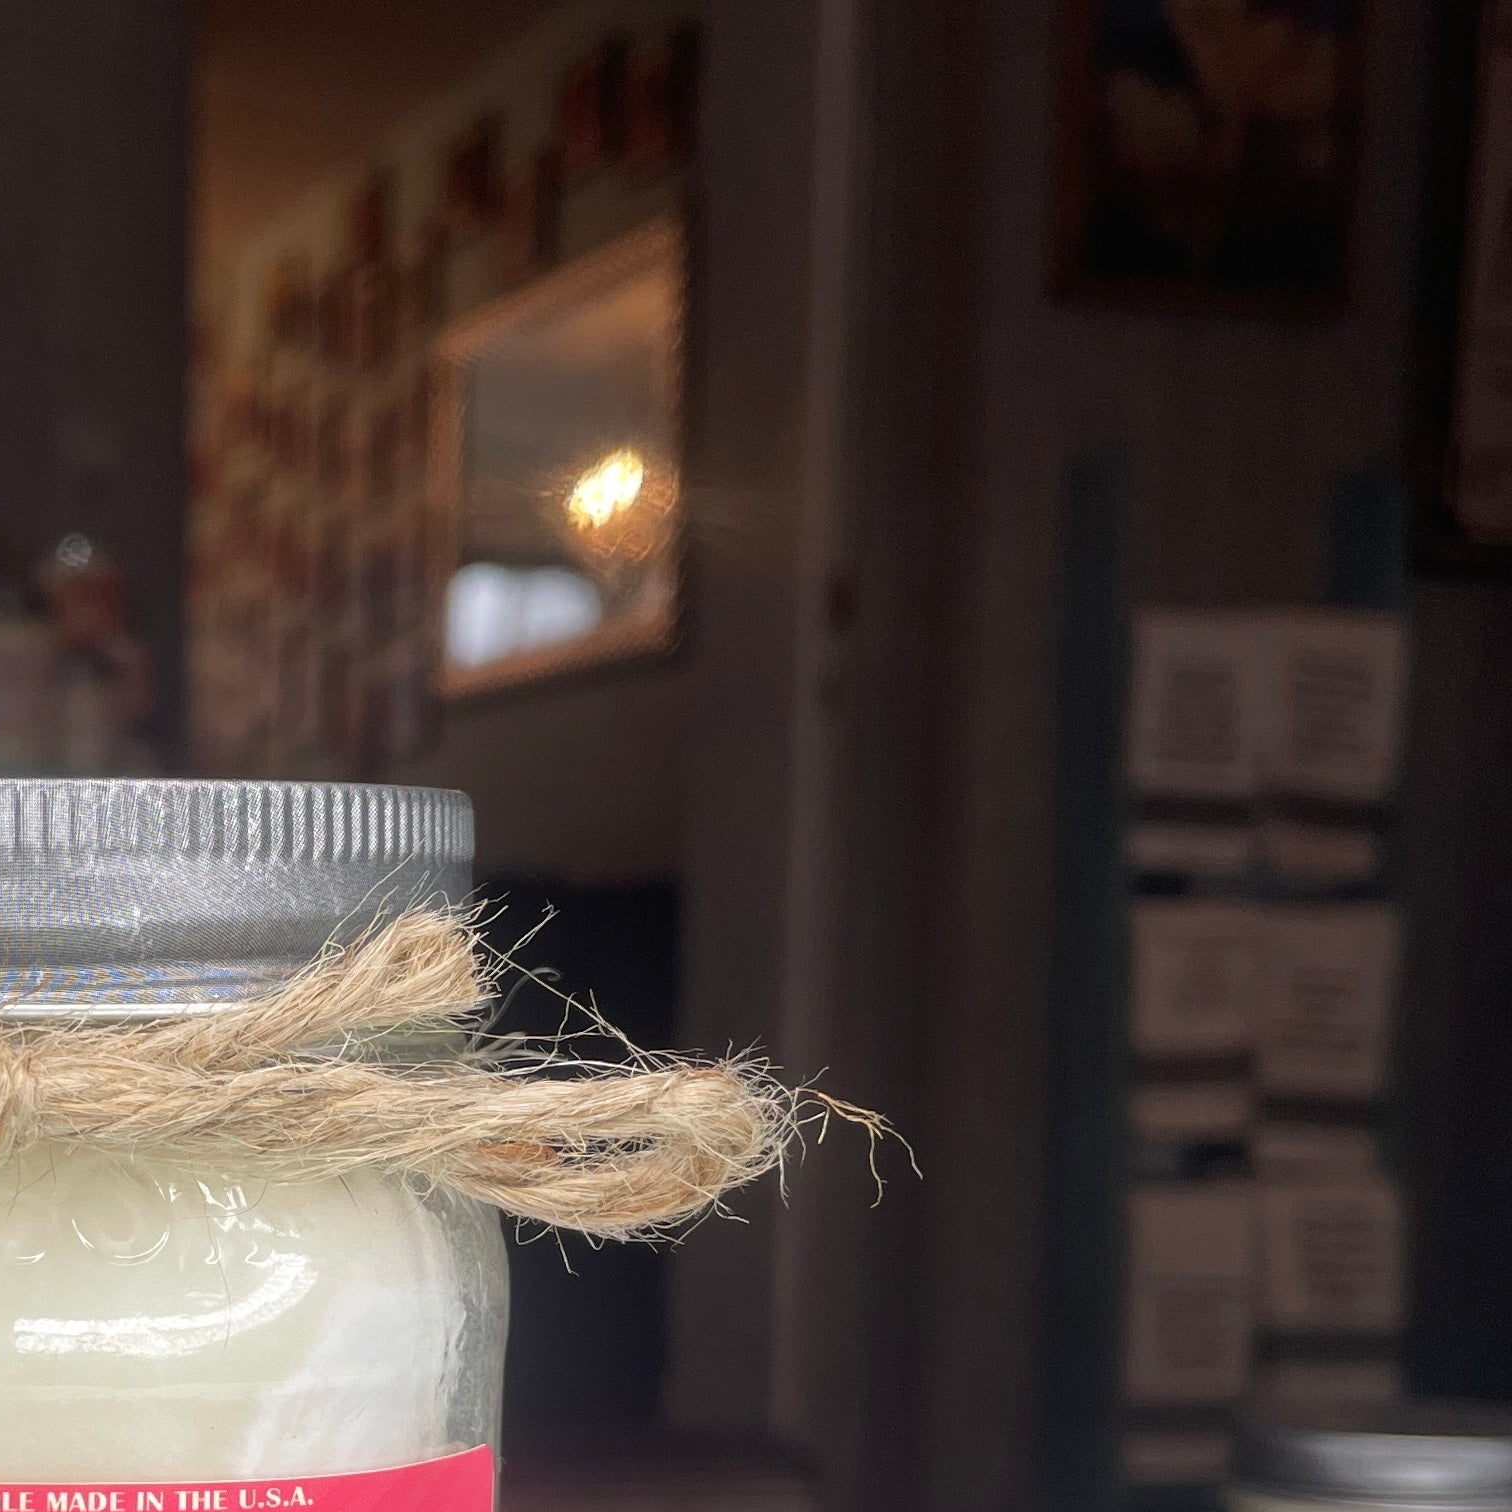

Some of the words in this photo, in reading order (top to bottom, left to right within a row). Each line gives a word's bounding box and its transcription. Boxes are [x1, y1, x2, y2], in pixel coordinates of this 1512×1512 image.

[135, 1490, 165, 1512] IN
[174, 1488, 228, 1512] THE
[238, 1485, 314, 1510] U.S.A.
